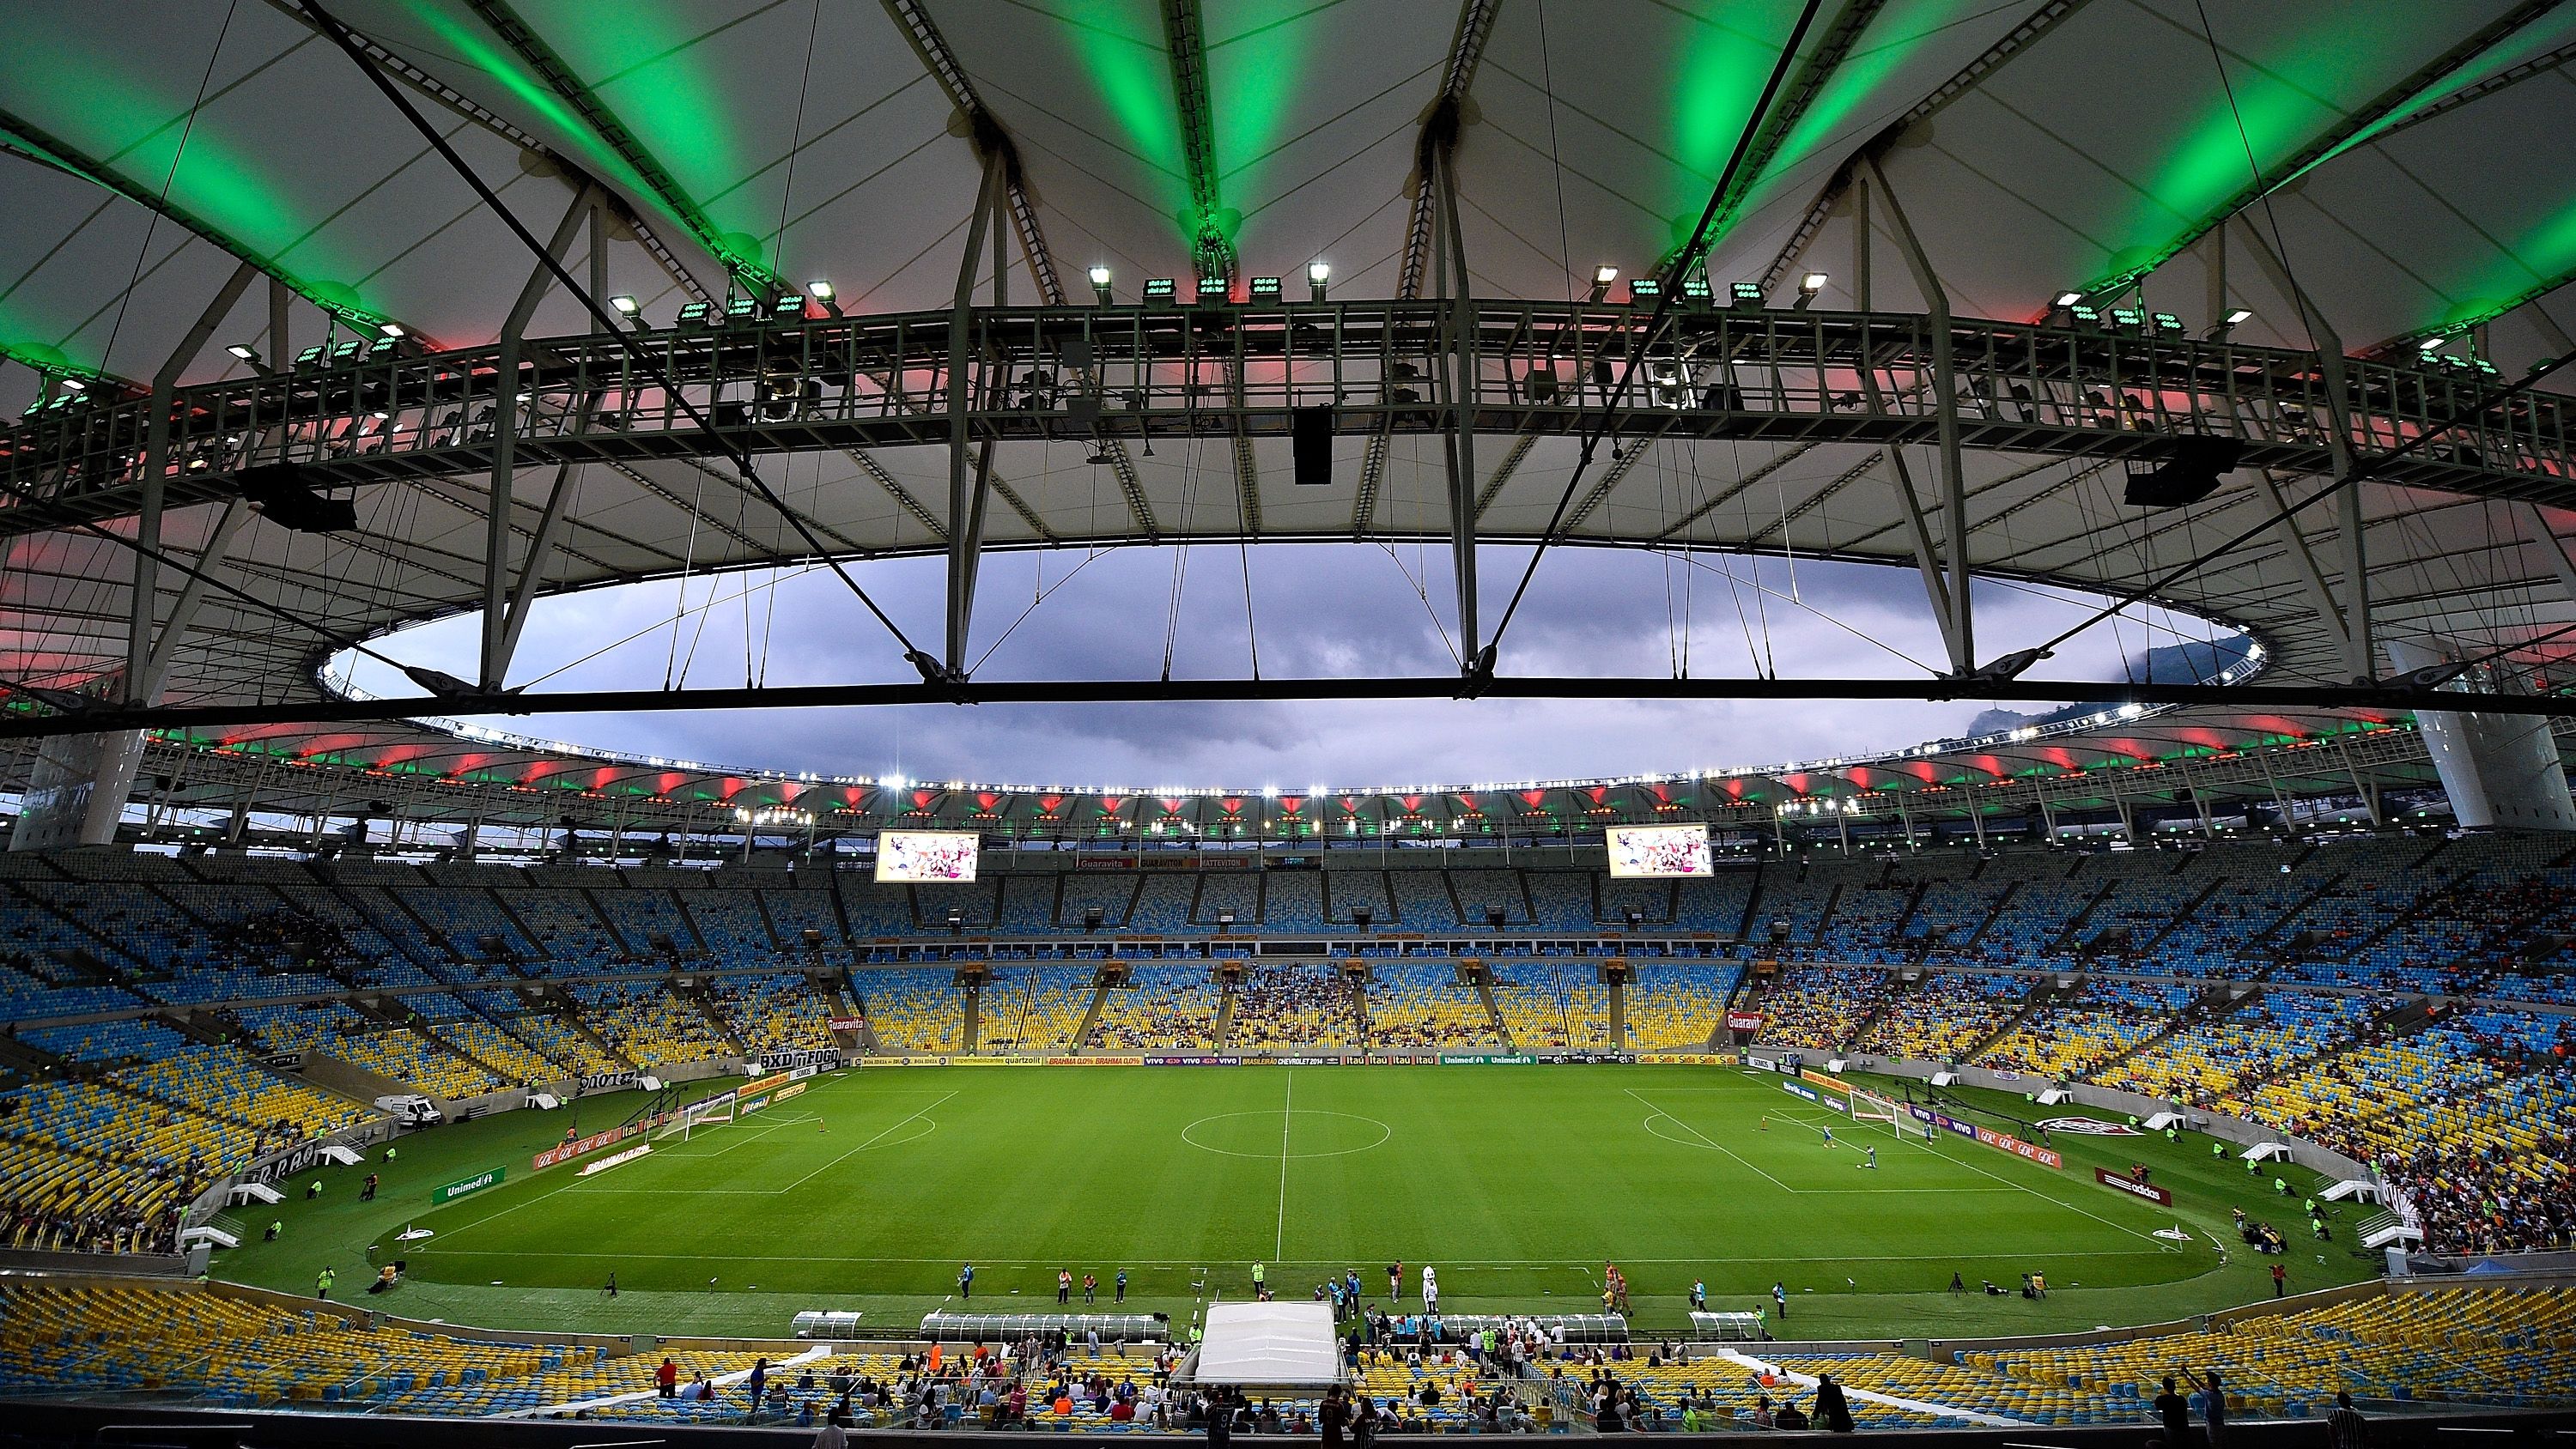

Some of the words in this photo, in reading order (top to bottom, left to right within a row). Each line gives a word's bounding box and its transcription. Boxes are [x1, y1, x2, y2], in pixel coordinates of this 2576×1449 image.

[808, 1049, 839, 1064] FOGO
[1347, 1056, 1364, 1064] Itaú
[1370, 1056, 1387, 1064] Itaú
[1393, 1056, 1410, 1064] Itaú
[1416, 1056, 1433, 1064] Itaú
[1638, 1055, 1655, 1064] Sadia
[1659, 1055, 1675, 1064] Sadia
[1679, 1055, 1695, 1064] Sadia
[1699, 1055, 1716, 1064] Sadia
[623, 1123, 638, 1138] Itaú
[447, 1176, 482, 1197] Unimed
[2132, 1184, 2160, 1200] adidas
[1124, 1385, 1129, 1395] 7
[1164, 1405, 1172, 1415] 10
